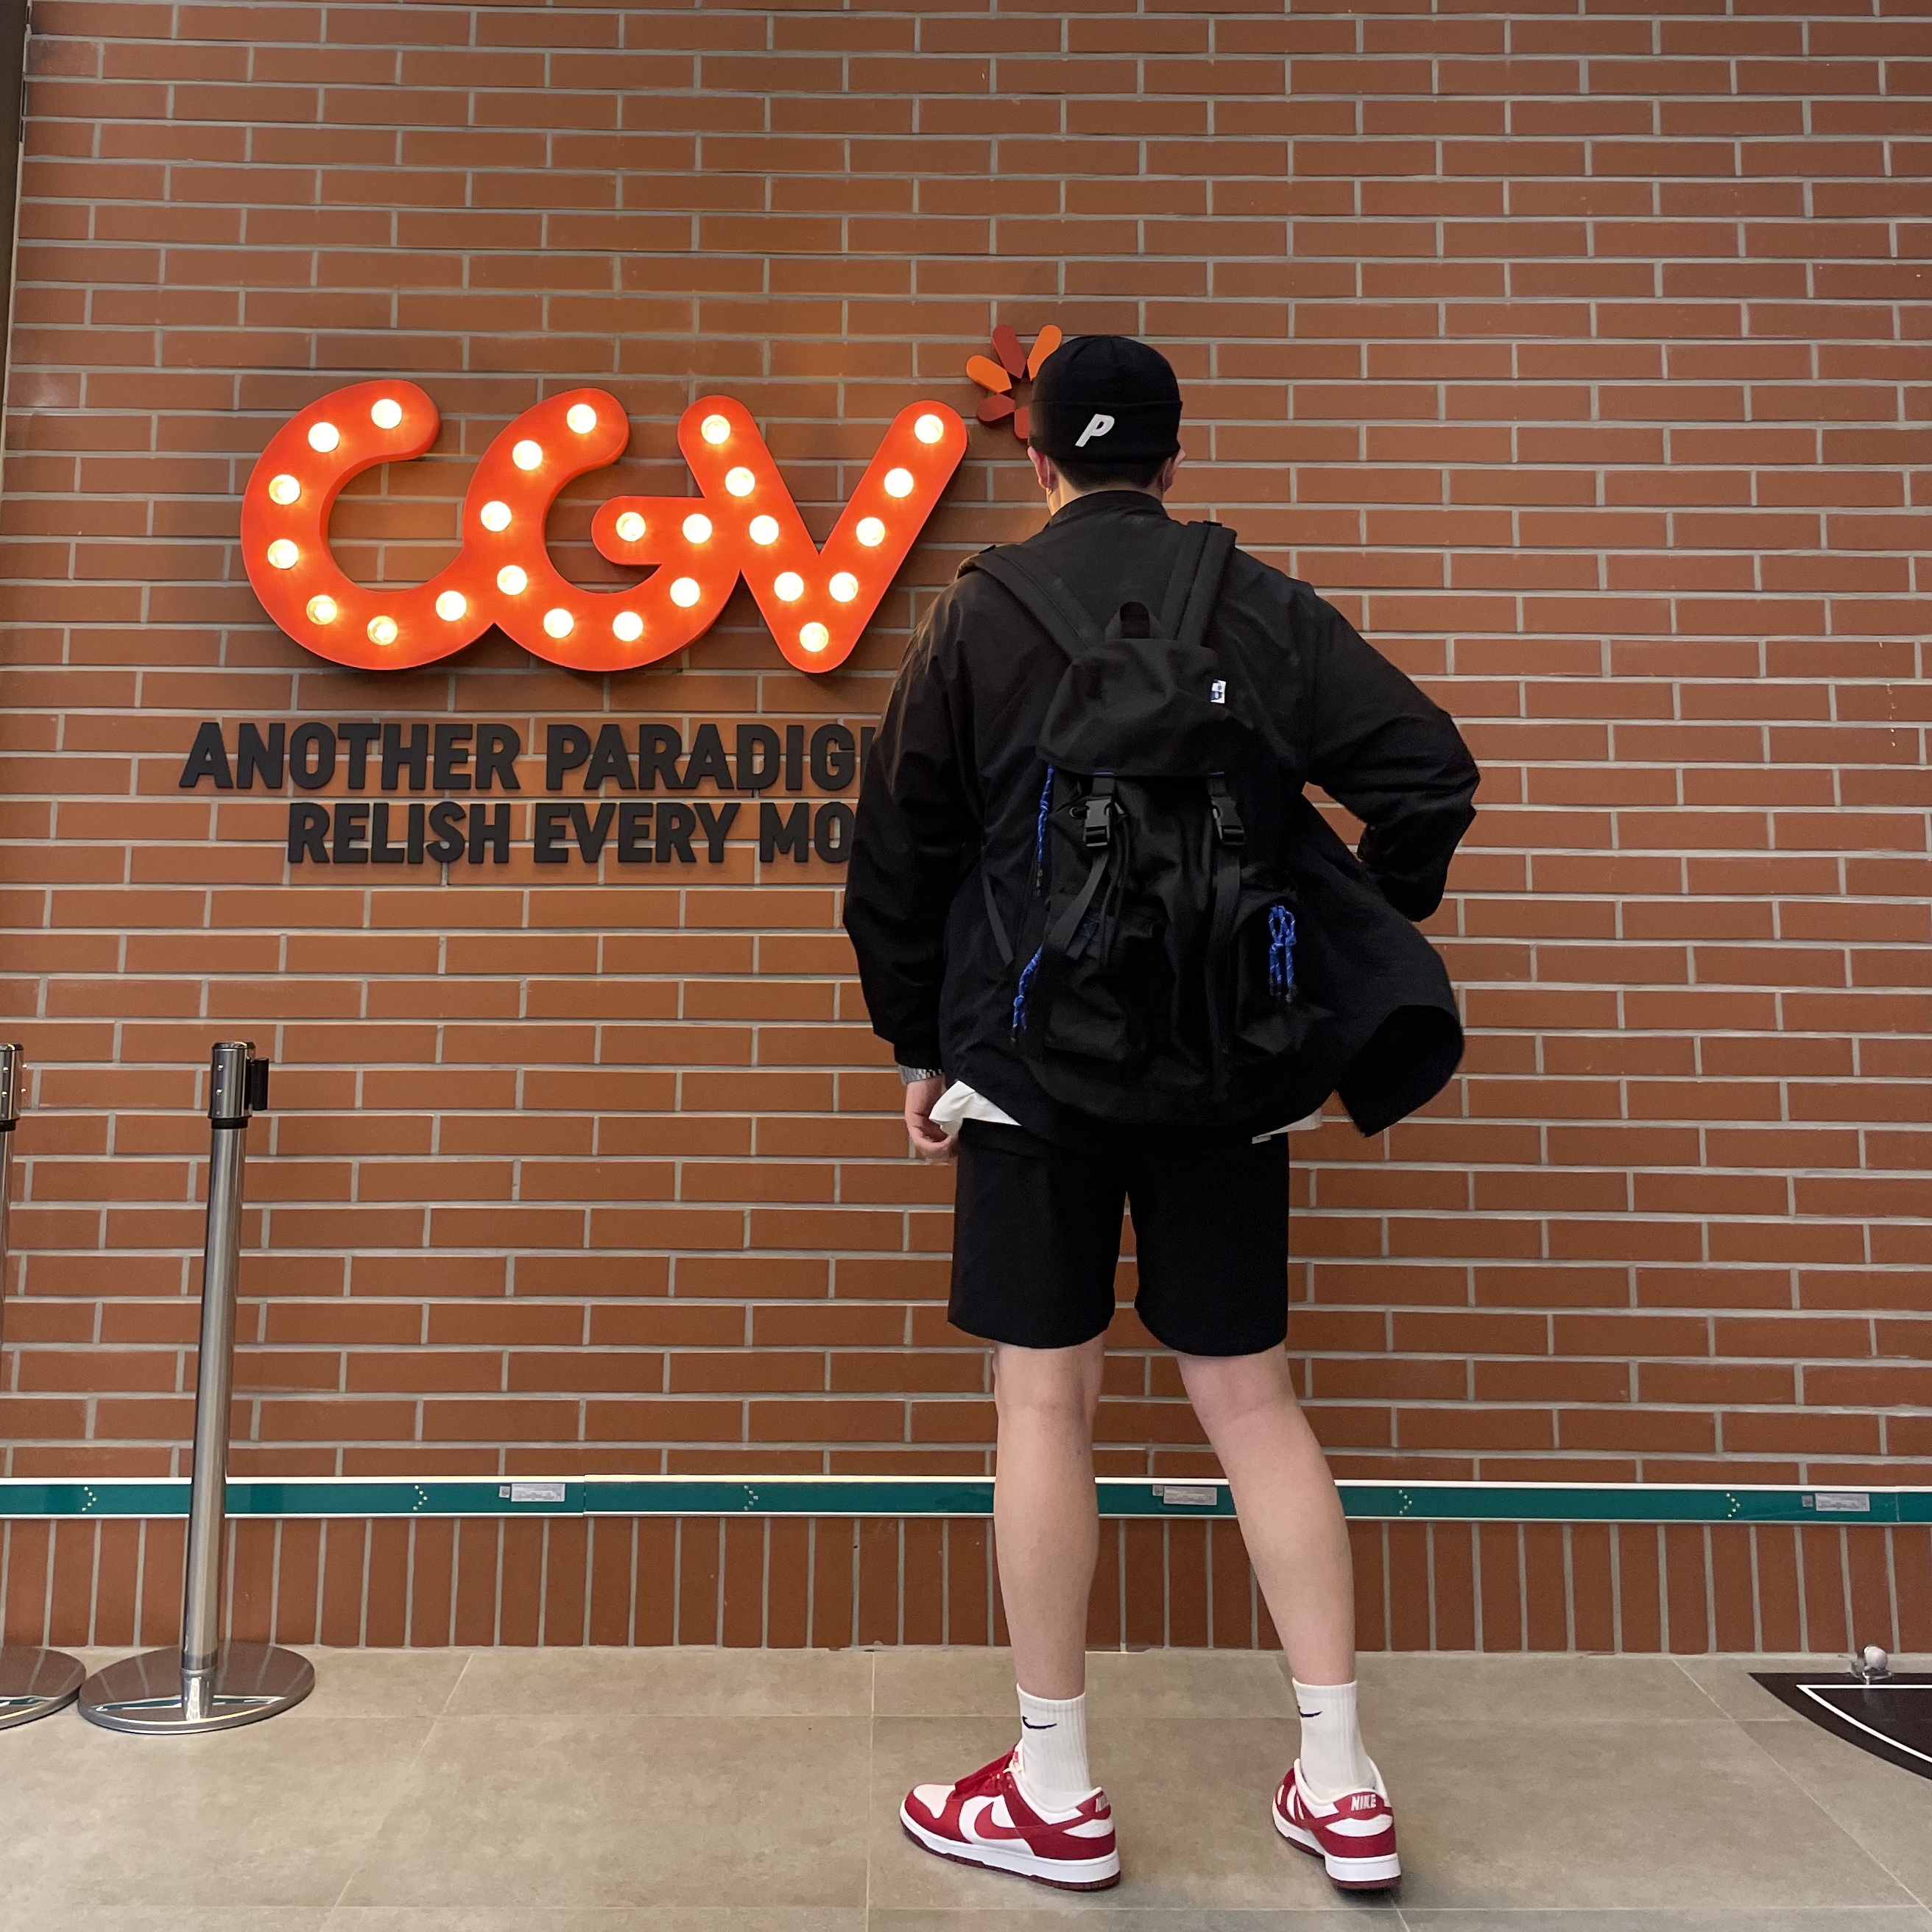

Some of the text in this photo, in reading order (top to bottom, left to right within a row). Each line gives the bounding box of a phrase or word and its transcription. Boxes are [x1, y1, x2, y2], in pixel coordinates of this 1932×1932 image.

[1075, 413, 1115, 448] P
[241, 379, 967, 673] CGV
[179, 722, 876, 792] ANOTHER PARADIG
[287, 801, 511, 864] RELISH
[534, 802, 741, 864] EVERY
[1350, 1794, 1377, 1811] NIKE
